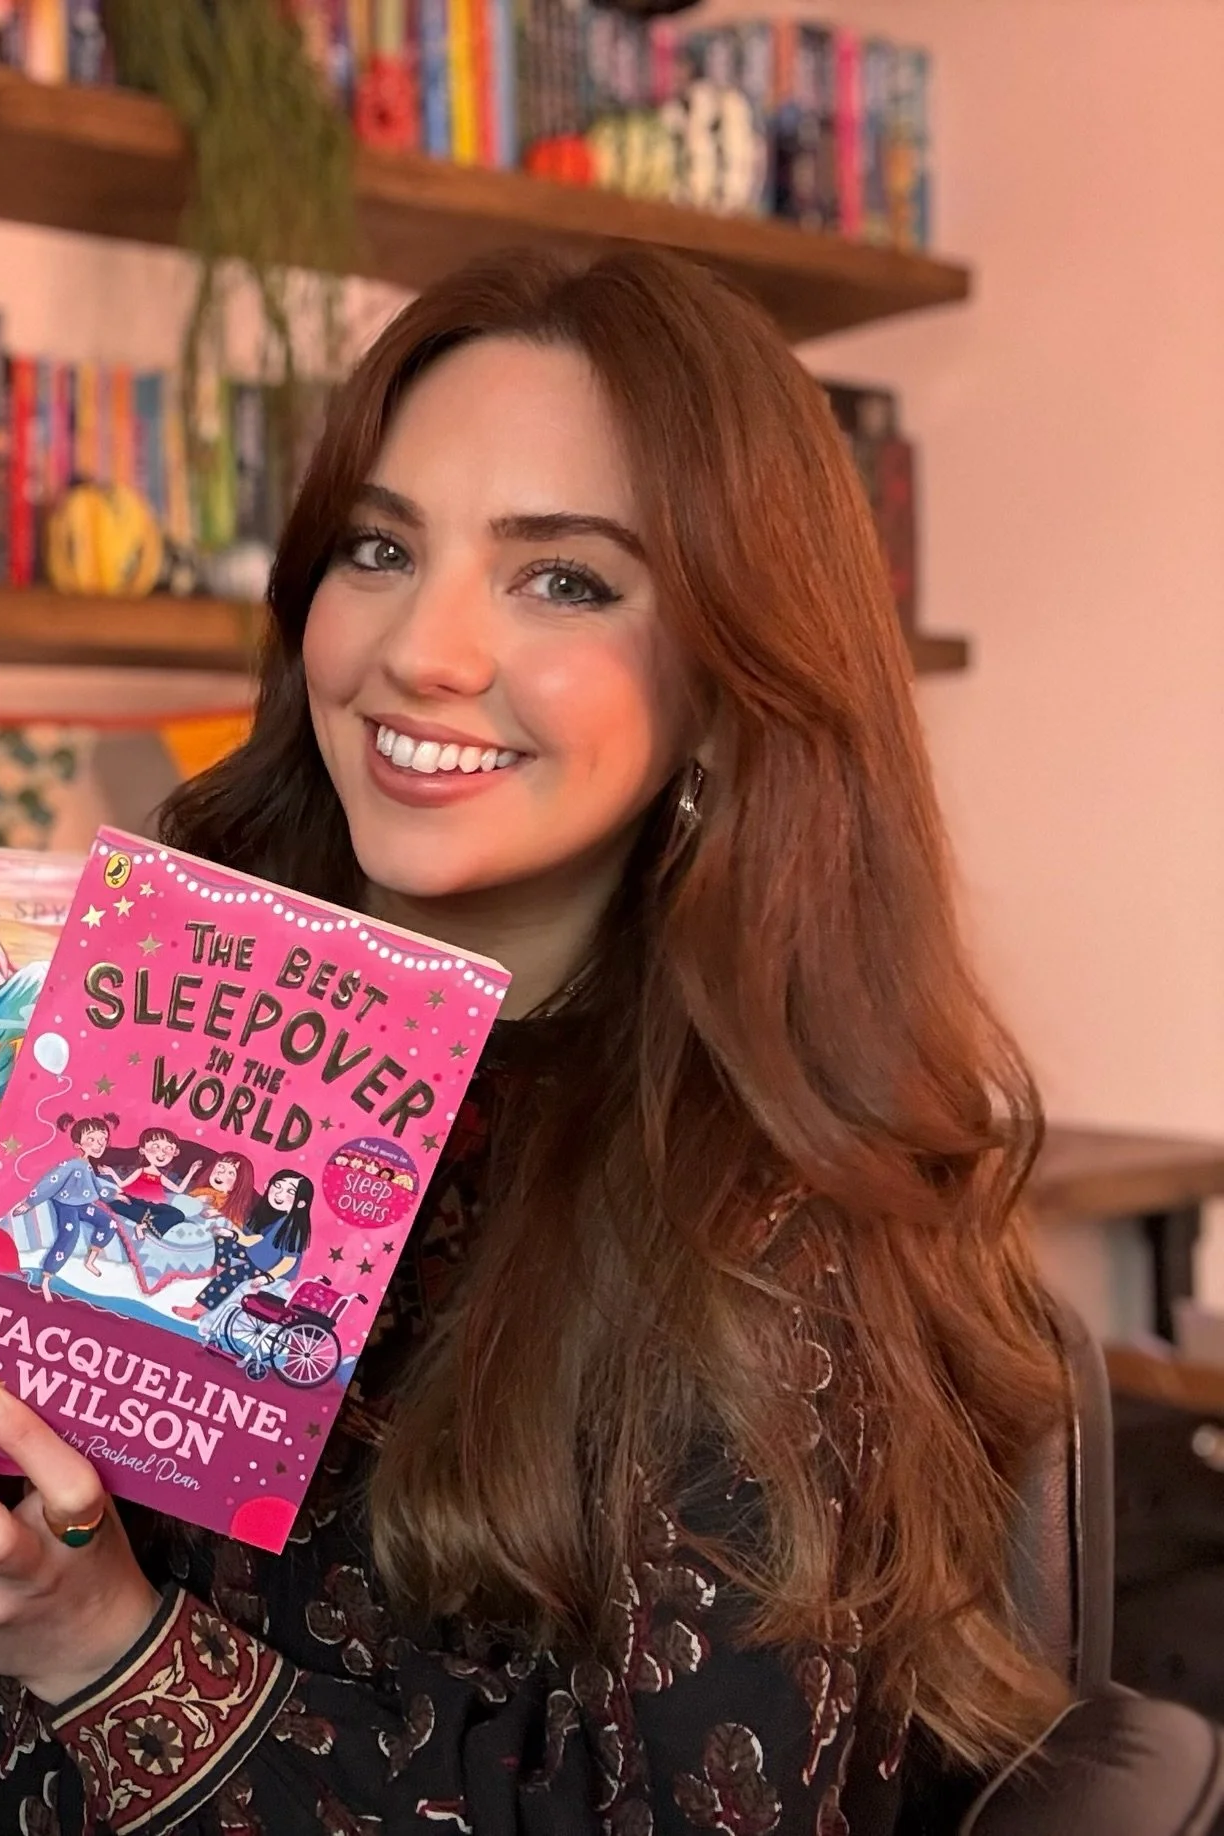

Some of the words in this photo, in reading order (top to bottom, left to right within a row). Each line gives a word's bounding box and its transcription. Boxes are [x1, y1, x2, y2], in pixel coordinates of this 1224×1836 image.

[185, 920, 257, 973] THE
[277, 945, 388, 1025] BEST
[85, 962, 436, 1138] SLEEPOVER
[208, 1046, 237, 1075] IN
[242, 1058, 286, 1096] THE
[152, 1054, 314, 1152] WORLD
[359, 1139, 380, 1153] Read
[338, 1194, 390, 1222] overs
[343, 1173, 393, 1204] sleep
[16, 1360, 223, 1465] WILSON
[84, 1434, 156, 1474] Rachael
[156, 1457, 202, 1492] Dean
